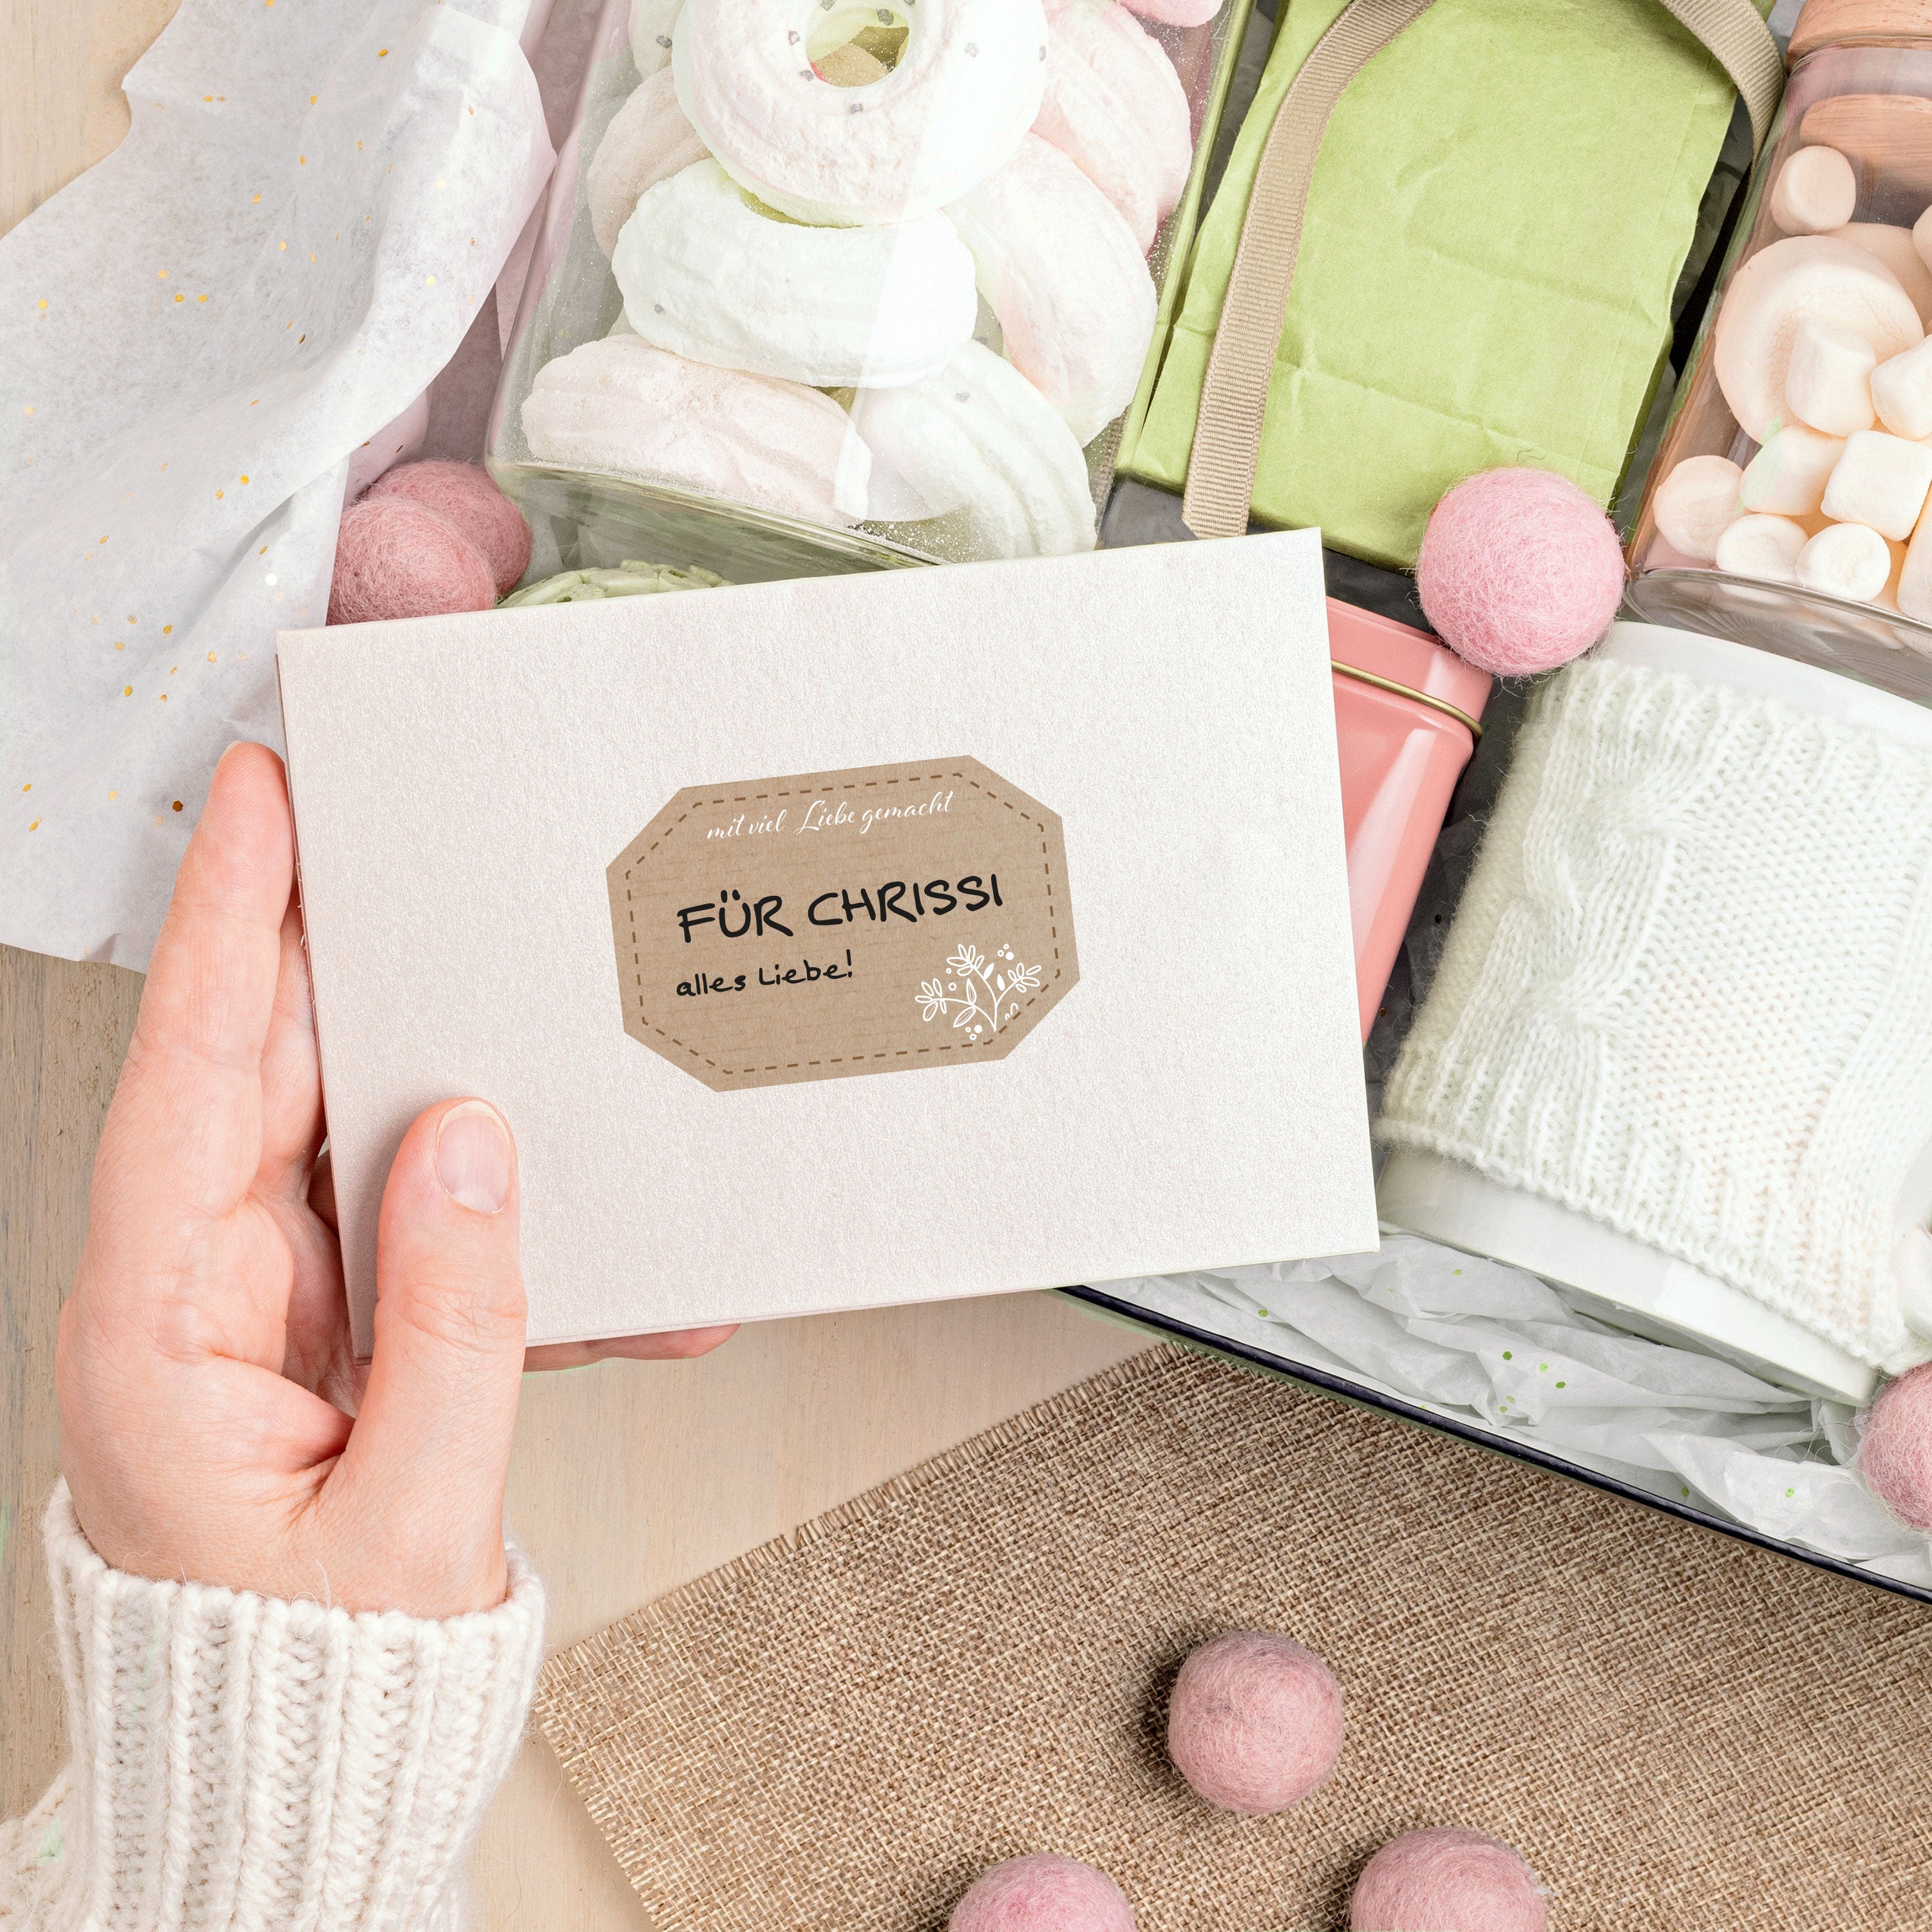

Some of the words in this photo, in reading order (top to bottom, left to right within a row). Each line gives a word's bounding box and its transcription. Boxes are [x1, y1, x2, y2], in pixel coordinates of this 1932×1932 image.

[706, 813, 746, 839] mit
[748, 809, 788, 835] viel
[793, 799, 856, 835] Liebe
[859, 790, 954, 835] gemacht
[677, 889, 794, 943] FÜR
[808, 873, 1003, 926] CHRISSI
[676, 972, 746, 997] alles
[759, 949, 853, 986] Liebe!
